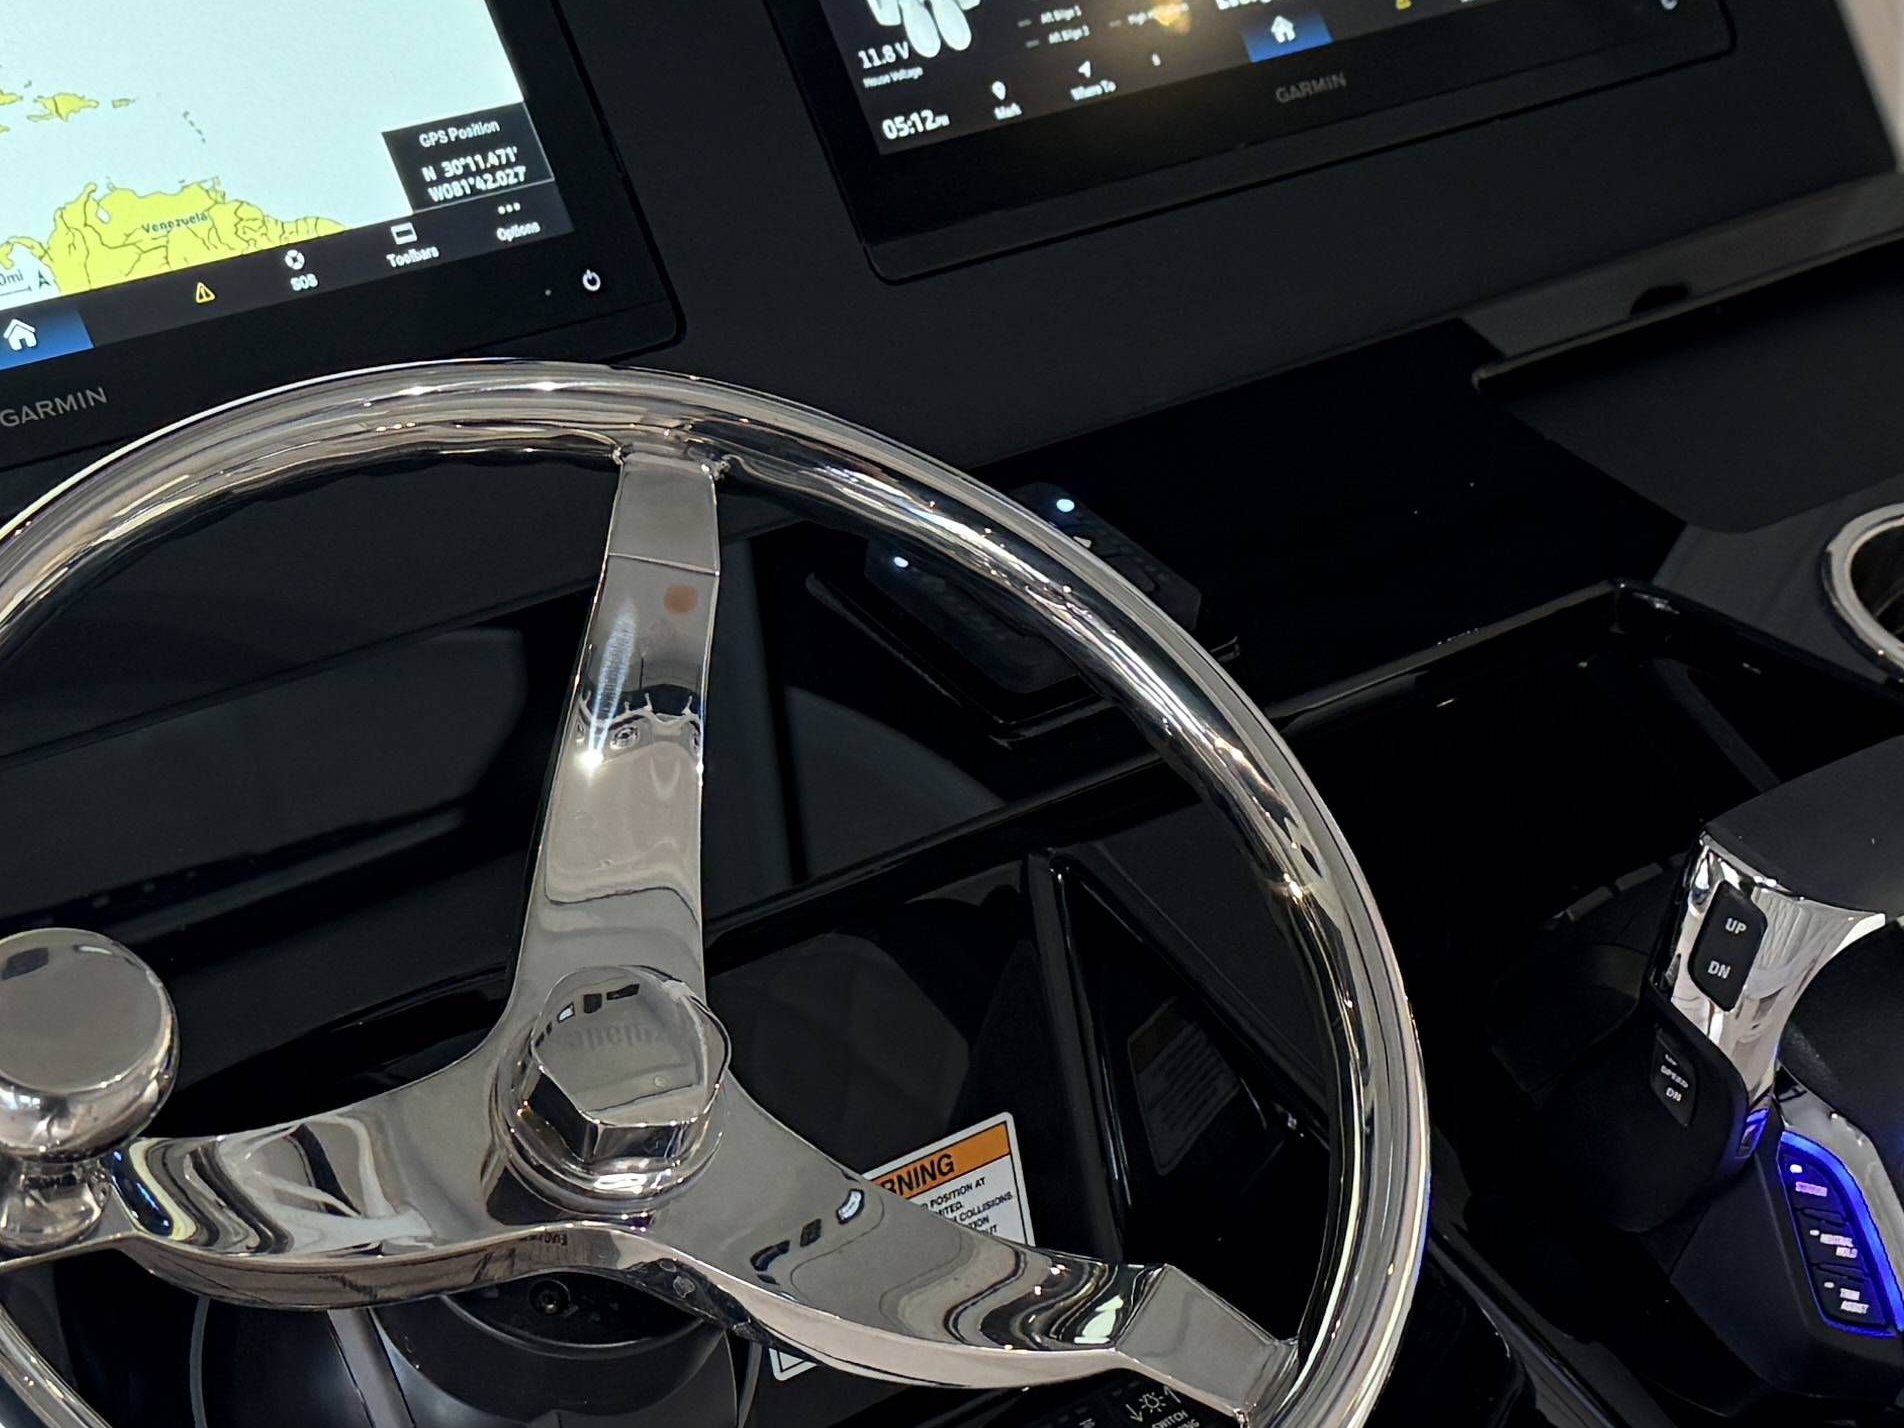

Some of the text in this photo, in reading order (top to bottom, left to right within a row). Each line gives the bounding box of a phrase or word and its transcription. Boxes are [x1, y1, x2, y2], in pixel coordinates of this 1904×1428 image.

[858, 41, 910, 69] 11.8 V
[1275, 74, 1348, 104] GARMIN
[419, 120, 501, 148] GPS Position
[421, 165, 438, 182] N
[141, 210, 208, 234] Venezuela
[496, 221, 541, 243] Options
[386, 245, 440, 268] Toolbars
[290, 273, 318, 292] SOS
[0, 386, 109, 428] GARMIN
[1725, 917, 1747, 935] UP
[1707, 960, 1732, 980] DN
[975, 1176, 987, 1189] AT
[960, 1191, 1014, 1222] COLLISIONS
